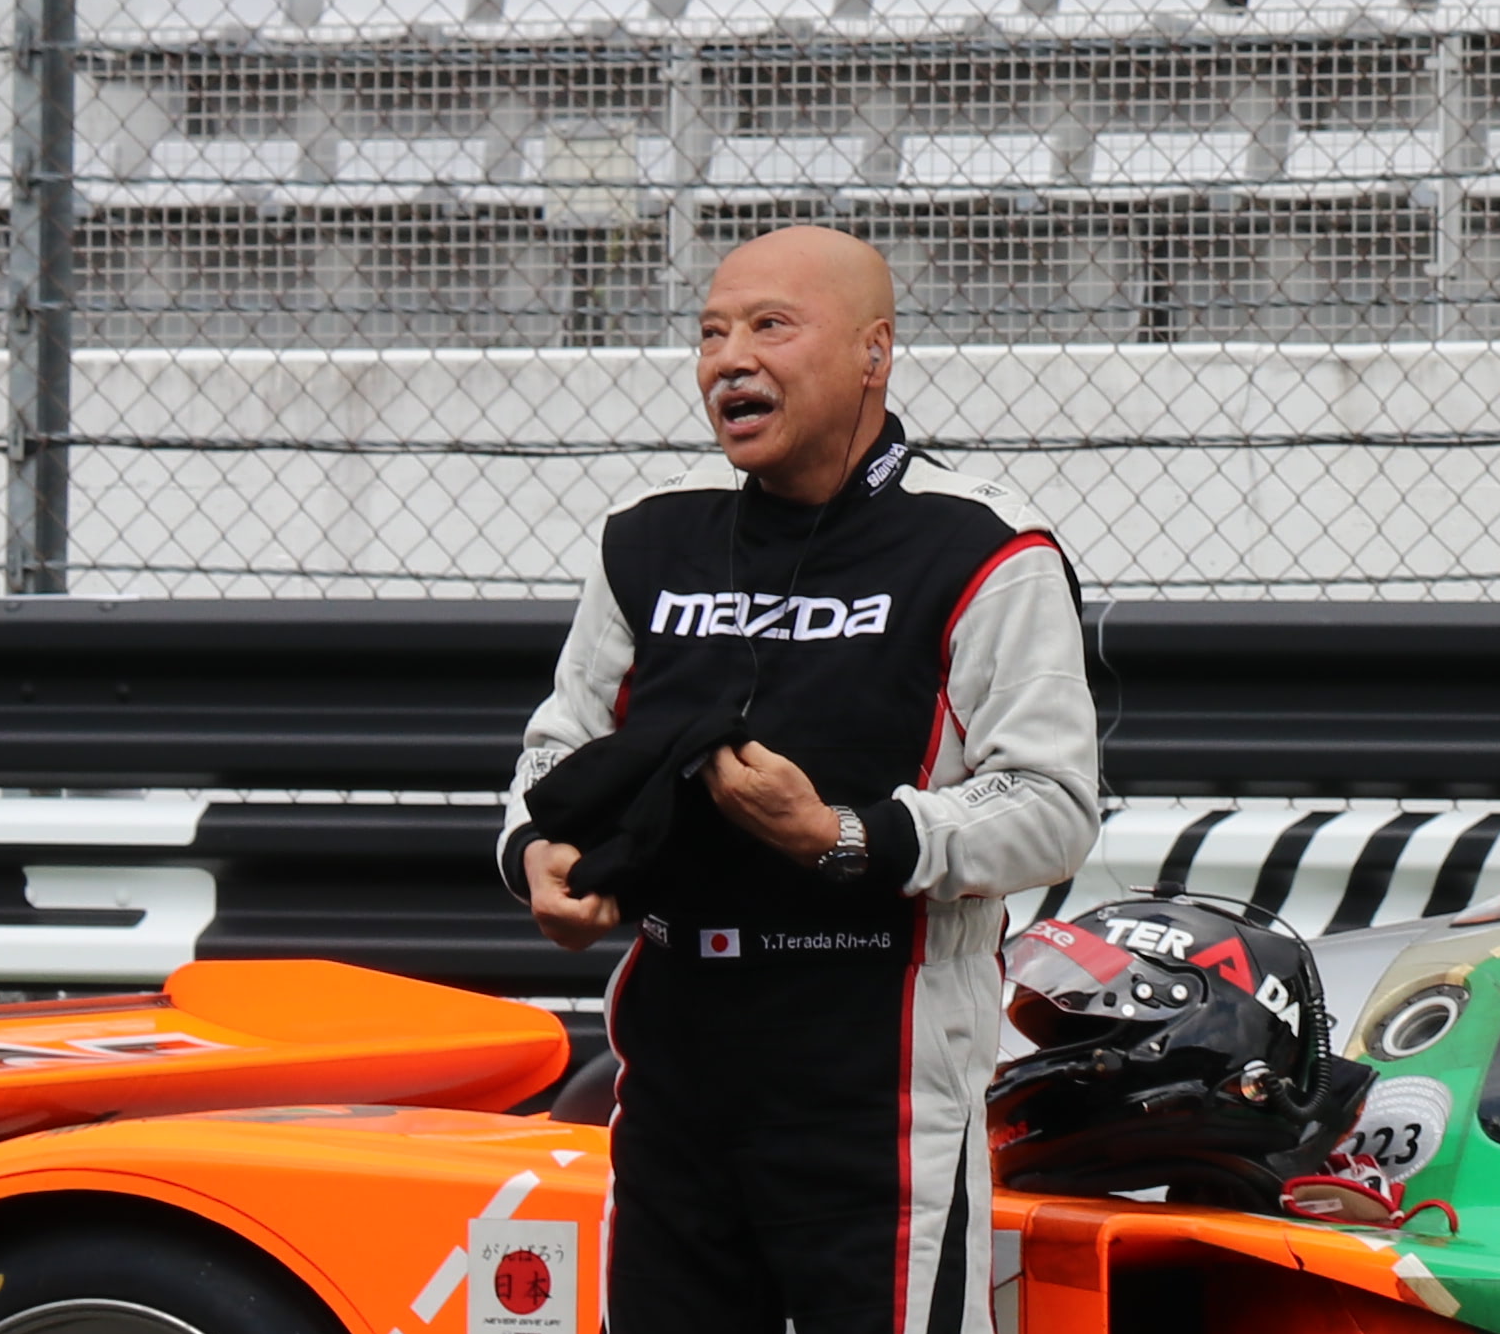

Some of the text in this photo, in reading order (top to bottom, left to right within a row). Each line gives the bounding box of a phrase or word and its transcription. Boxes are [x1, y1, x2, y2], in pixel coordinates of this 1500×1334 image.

[761, 932, 892, 950] Y.Terada Rh+AB
[482, 1243, 565, 1266] がんばろう
[496, 1271, 553, 1307] 日本
